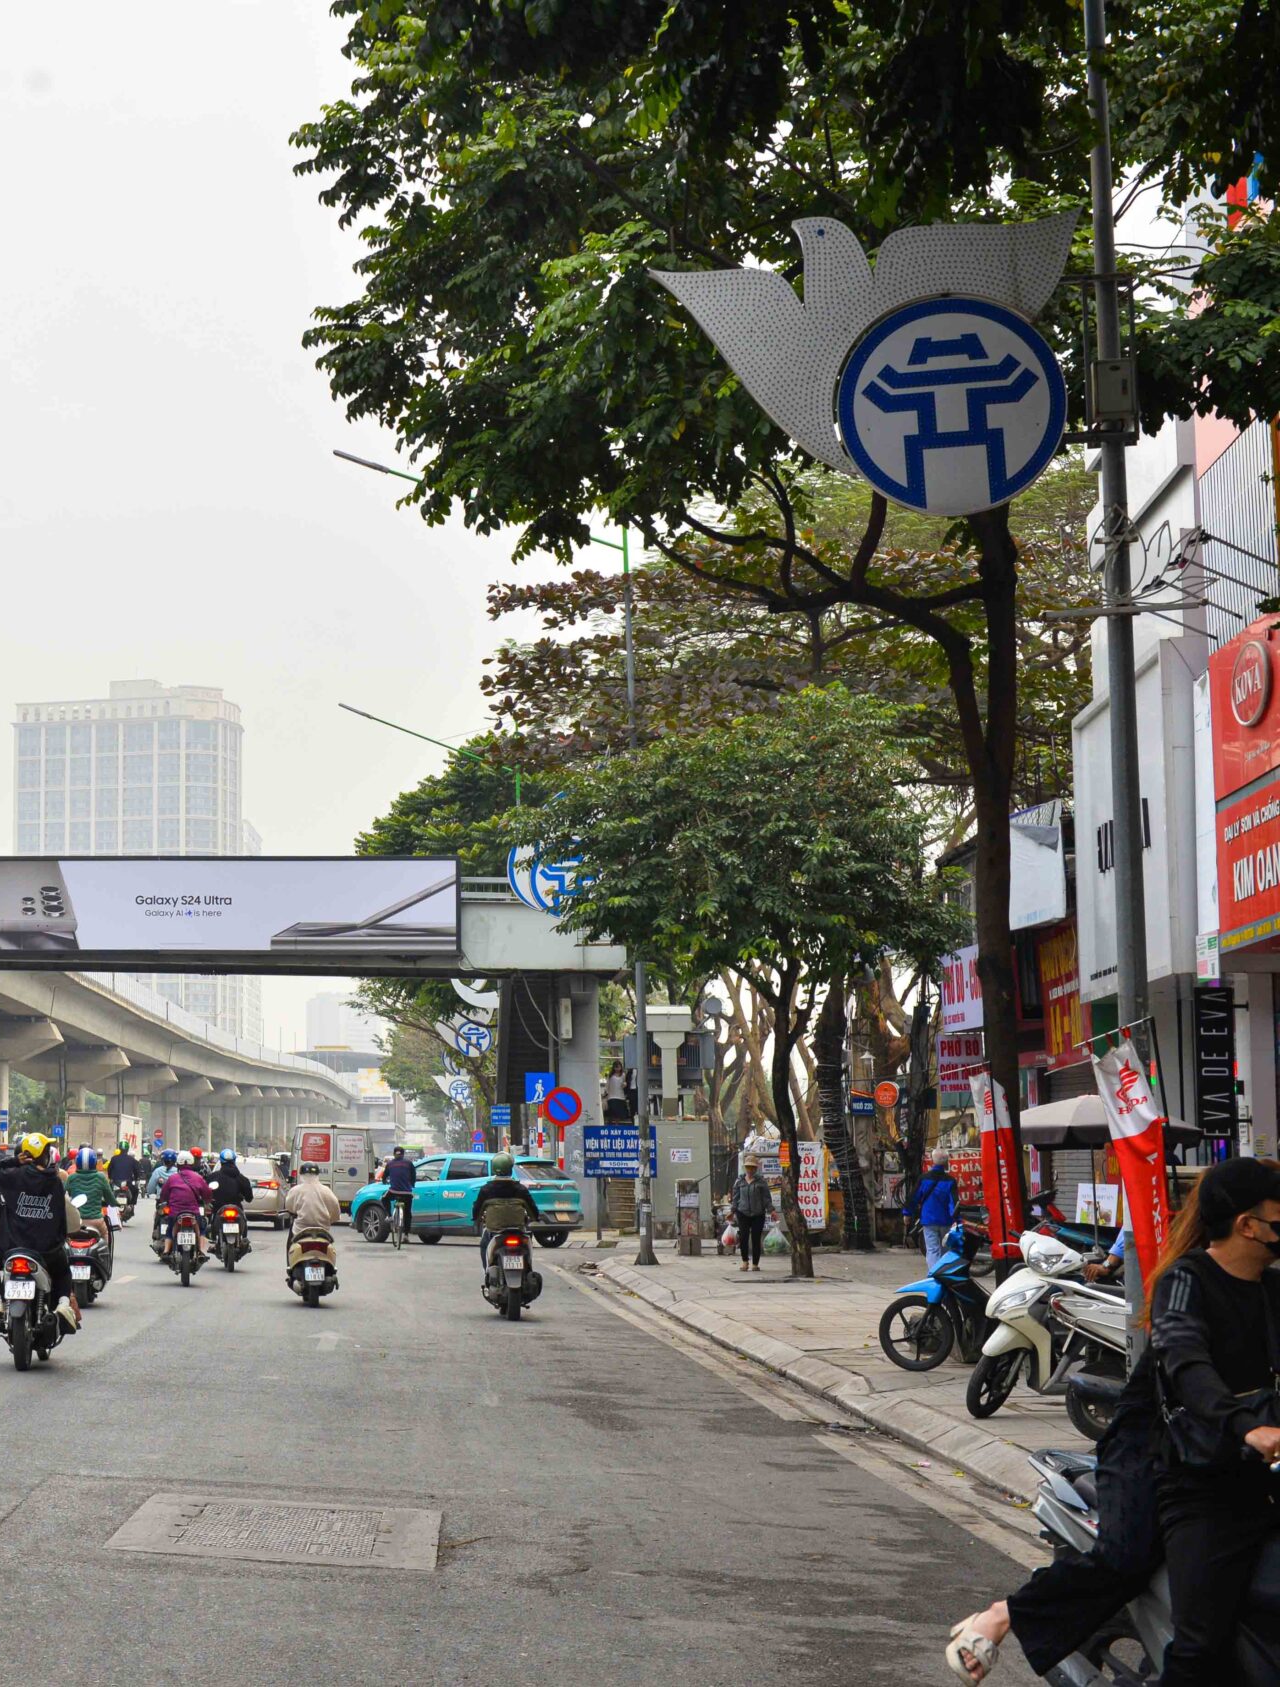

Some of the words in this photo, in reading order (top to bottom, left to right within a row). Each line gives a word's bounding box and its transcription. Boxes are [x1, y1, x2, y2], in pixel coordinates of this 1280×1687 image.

[1235, 662, 1262, 705] KOVA
[1233, 854, 1255, 903] KIM
[135, 895, 179, 908] Galaxy
[181, 895, 201, 905] S24
[204, 895, 232, 905] Ultra
[144, 909, 174, 918] Galaxy
[193, 909, 200, 917] is
[202, 909, 222, 917] here
[1201, 1051, 1230, 1076] DE
[17, 1191, 53, 1207] lumi
[15, 1204, 49, 1219] lumi
